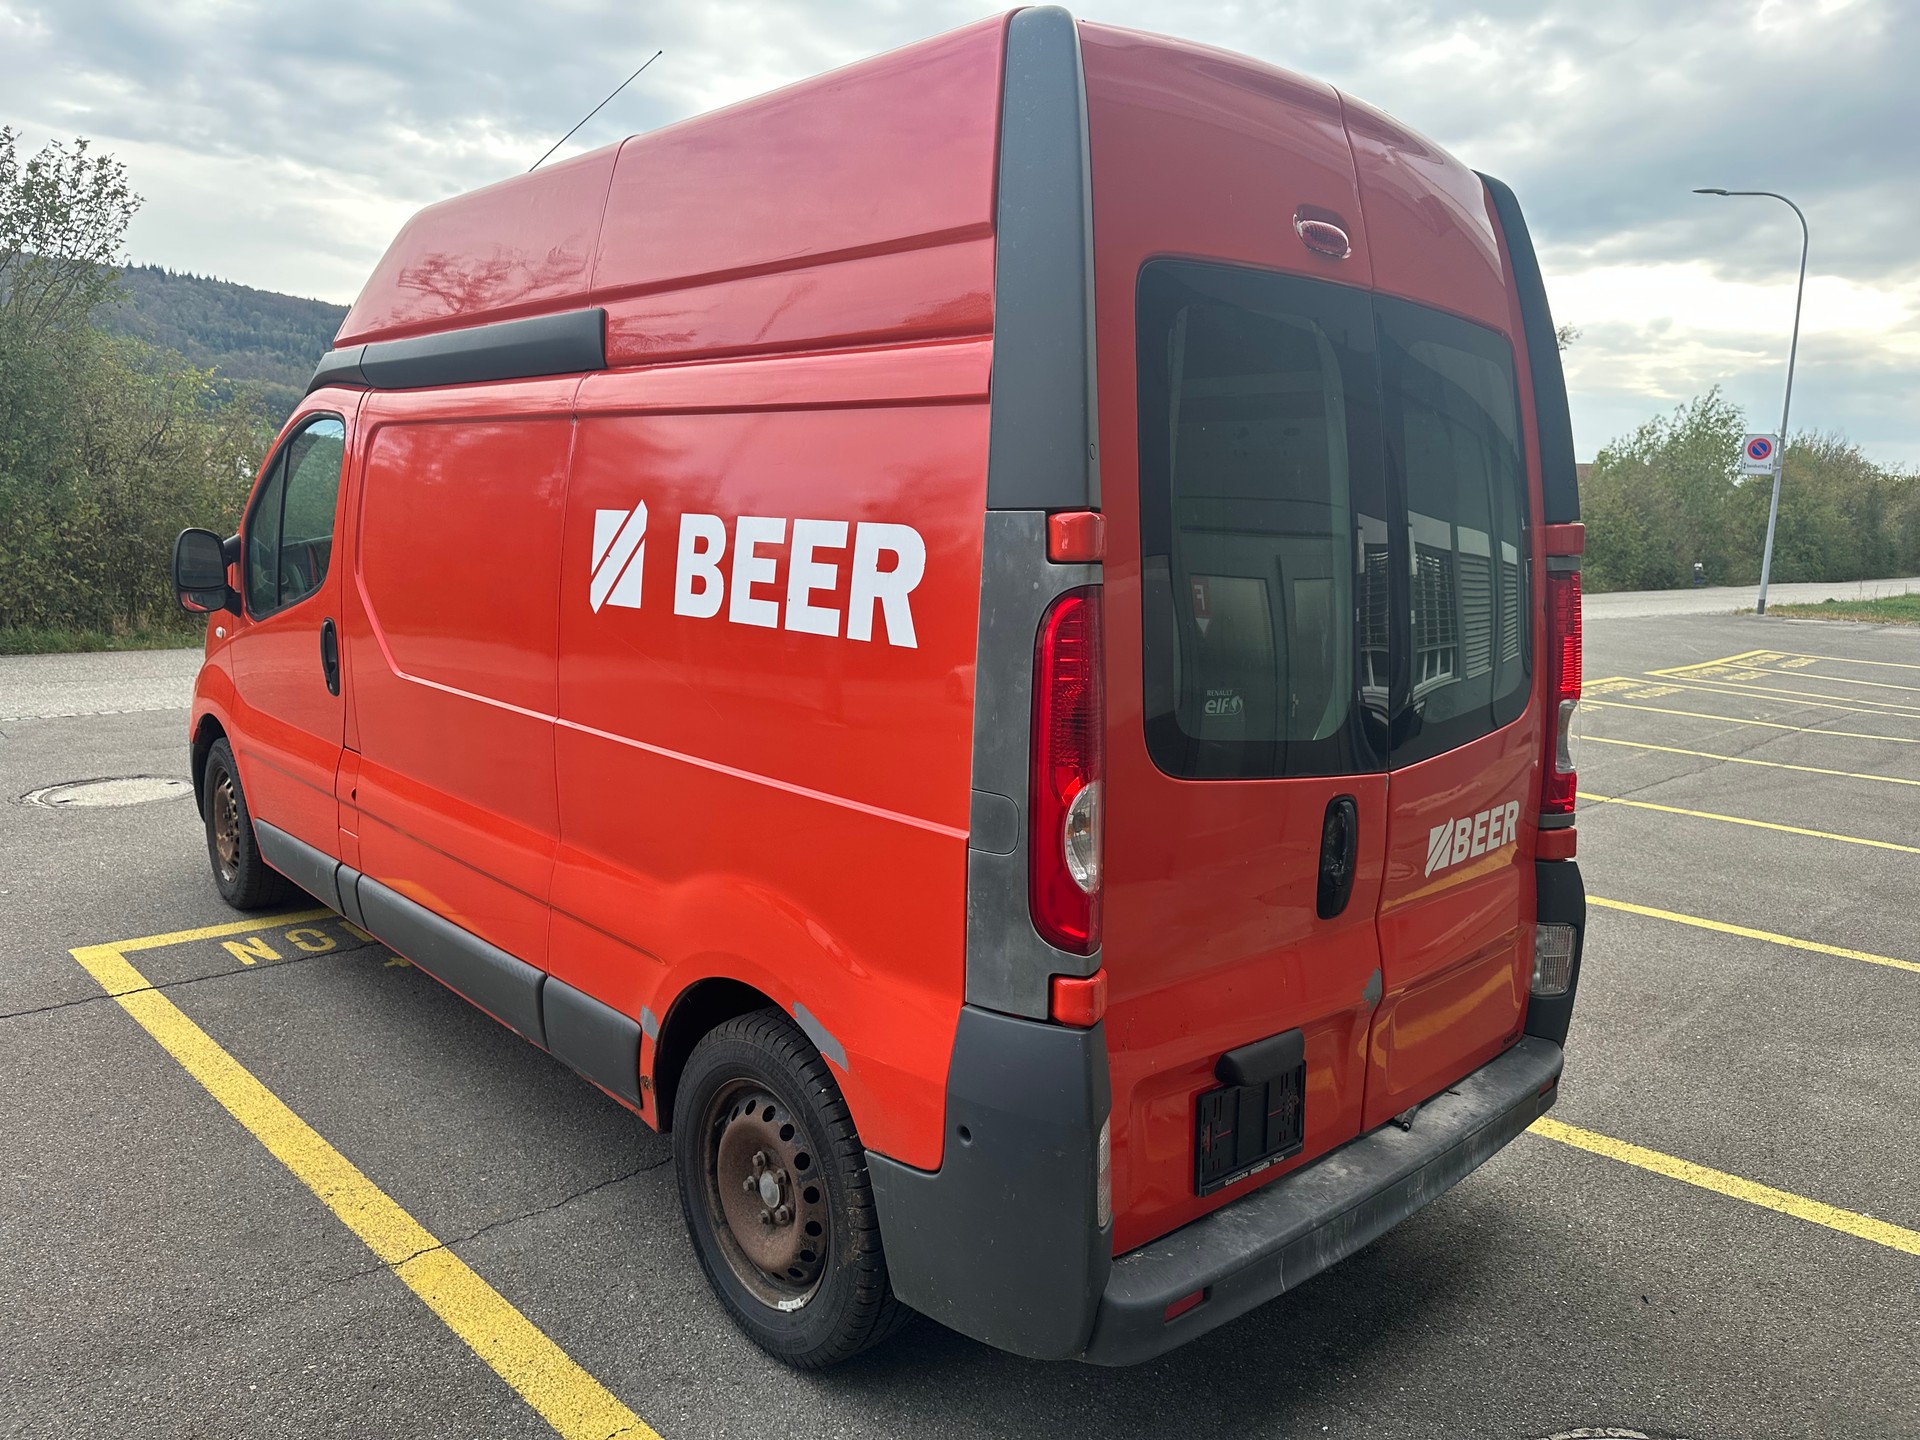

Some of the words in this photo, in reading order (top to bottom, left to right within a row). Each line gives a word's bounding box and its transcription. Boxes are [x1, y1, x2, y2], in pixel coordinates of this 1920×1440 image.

[673, 512, 927, 649] BEER
[1204, 697, 1230, 714] elf
[1206, 689, 1233, 697] RENAULT
[1450, 799, 1520, 866] BEER
